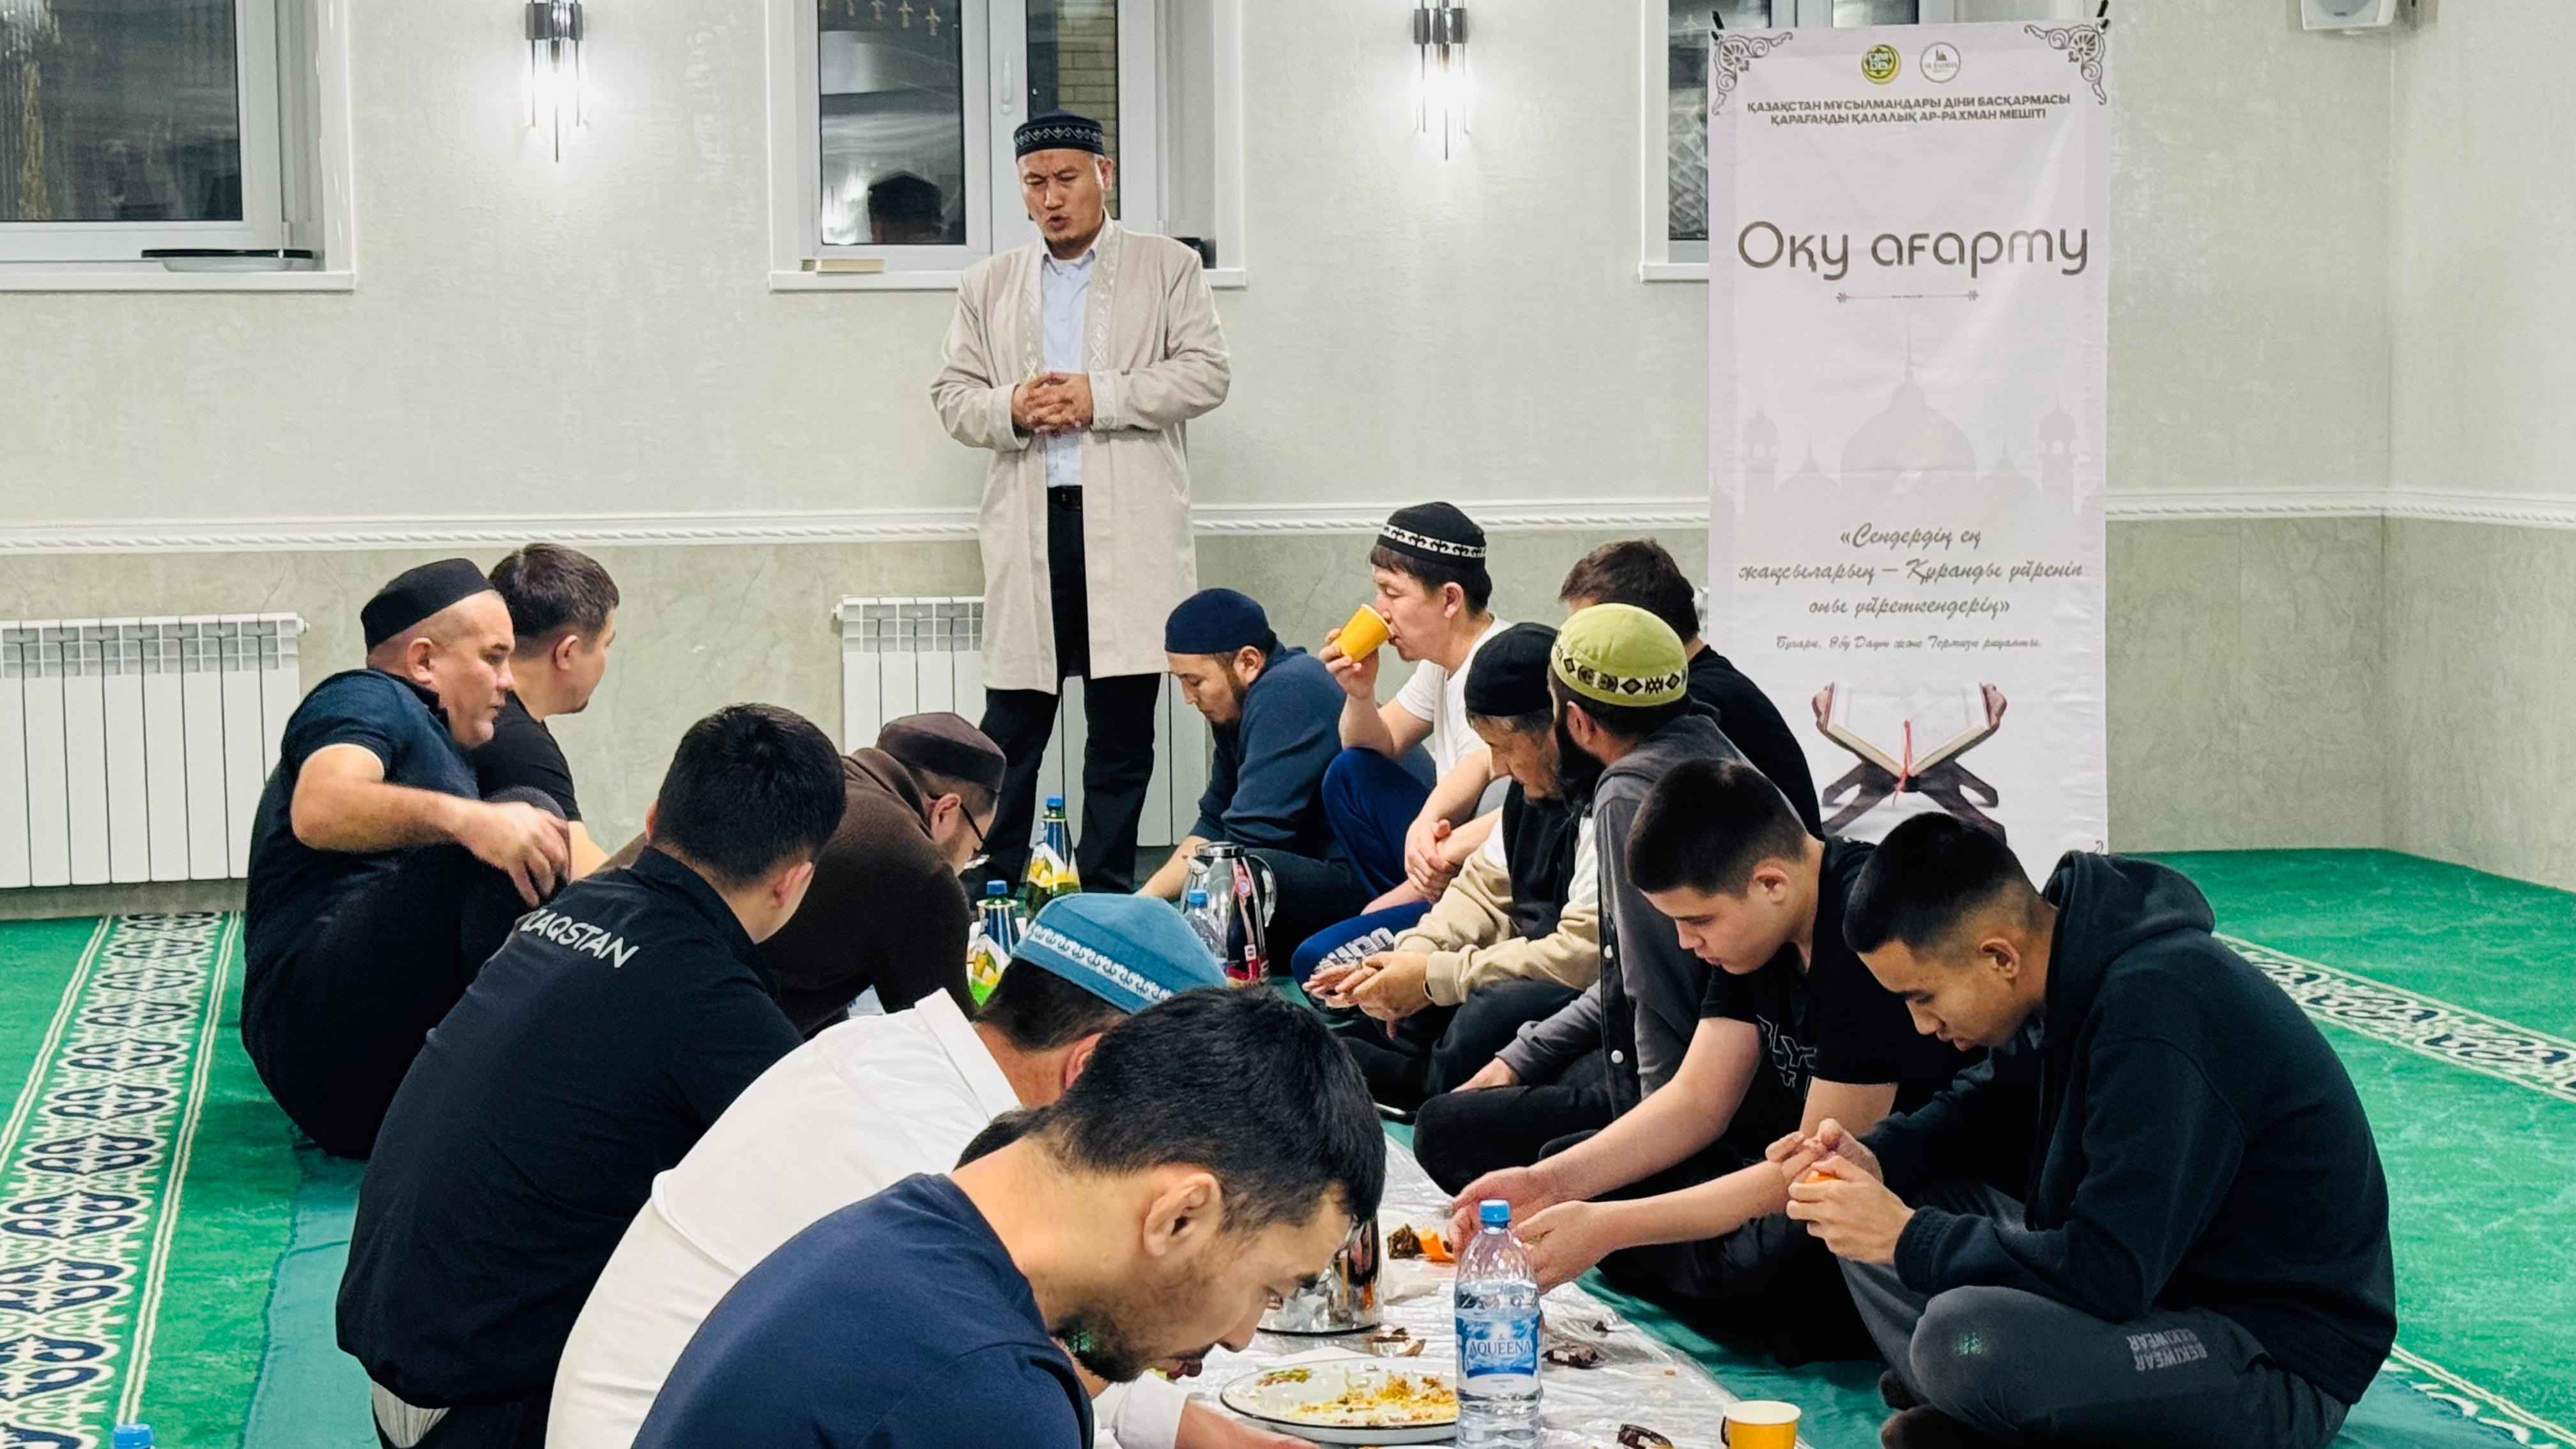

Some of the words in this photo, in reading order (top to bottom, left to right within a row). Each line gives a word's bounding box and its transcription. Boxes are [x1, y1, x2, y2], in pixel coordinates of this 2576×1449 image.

[1747, 101, 1821, 114] ҚАЗАҚСТАН
[1977, 94, 2071, 107] БАСҚАРМАСЫ
[1851, 111, 1918, 123] ҚАЛАЛЫҚ
[1919, 109, 1997, 121] АР-РАХМАН
[1999, 108, 2046, 119] МЕШІТІ
[1738, 221, 1848, 281] Оқу
[1871, 228, 2088, 279] ағарту
[1840, 523, 1952, 550] «Сендердің
[1960, 530, 1981, 549] ең
[1738, 564, 1875, 586] жақсыларың
[1809, 598, 1848, 614] оны
[1469, 1340, 1531, 1356] AQUEENA
